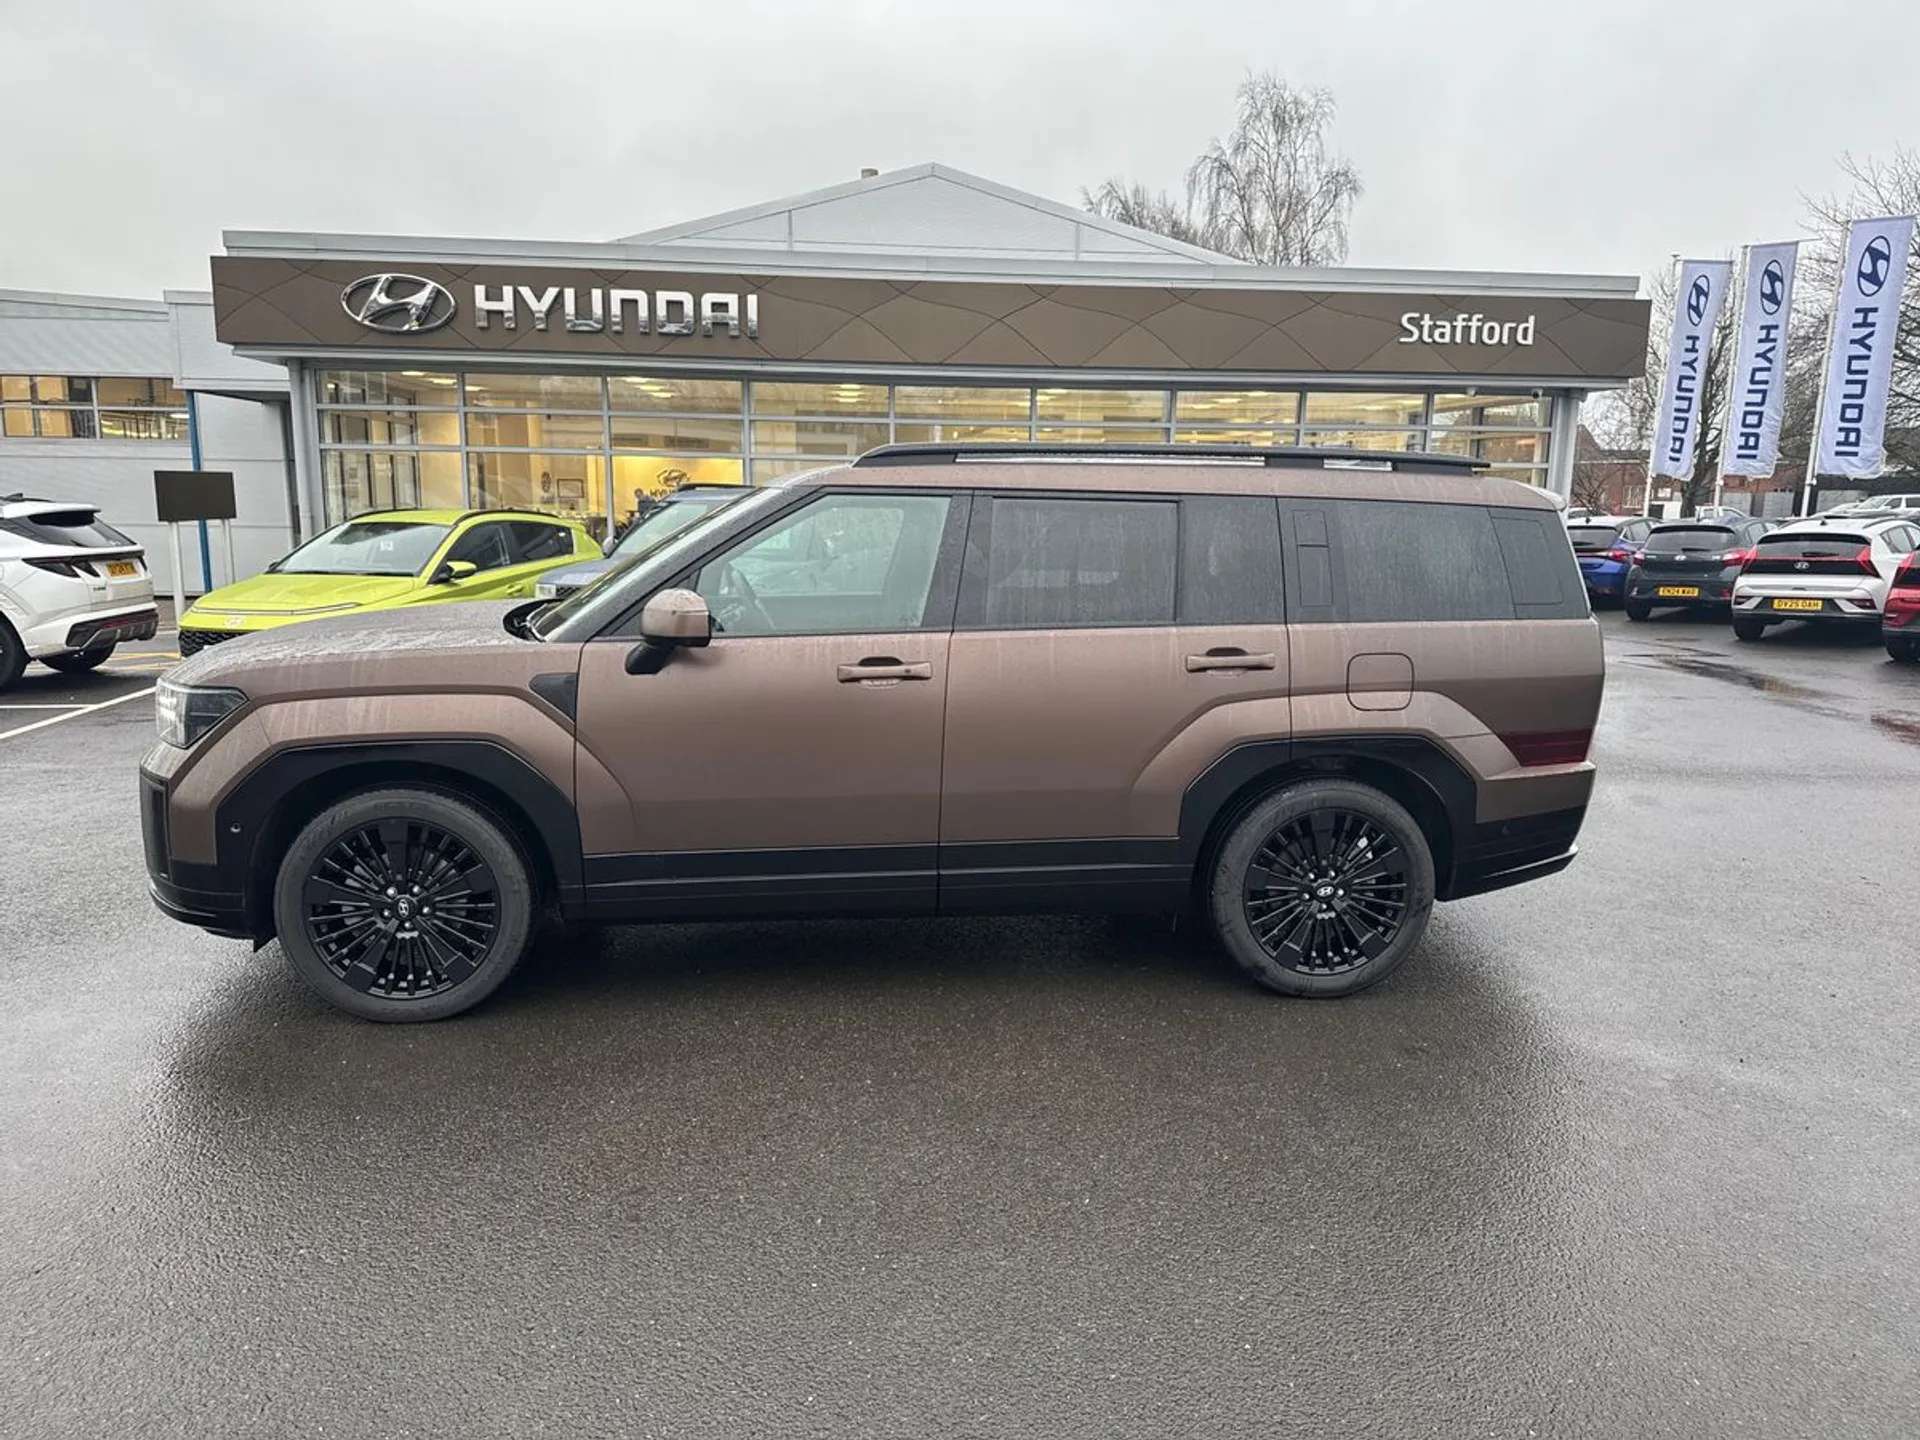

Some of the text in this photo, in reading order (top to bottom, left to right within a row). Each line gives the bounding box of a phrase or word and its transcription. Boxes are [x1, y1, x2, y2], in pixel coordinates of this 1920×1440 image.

[474, 284, 759, 338] HYUNDAI
[1399, 312, 1536, 345] Stafford
[1668, 335, 1700, 462] HYUNDAI
[1736, 324, 1779, 459] HYUNDAI
[1834, 307, 1879, 457] HYUNDAI
